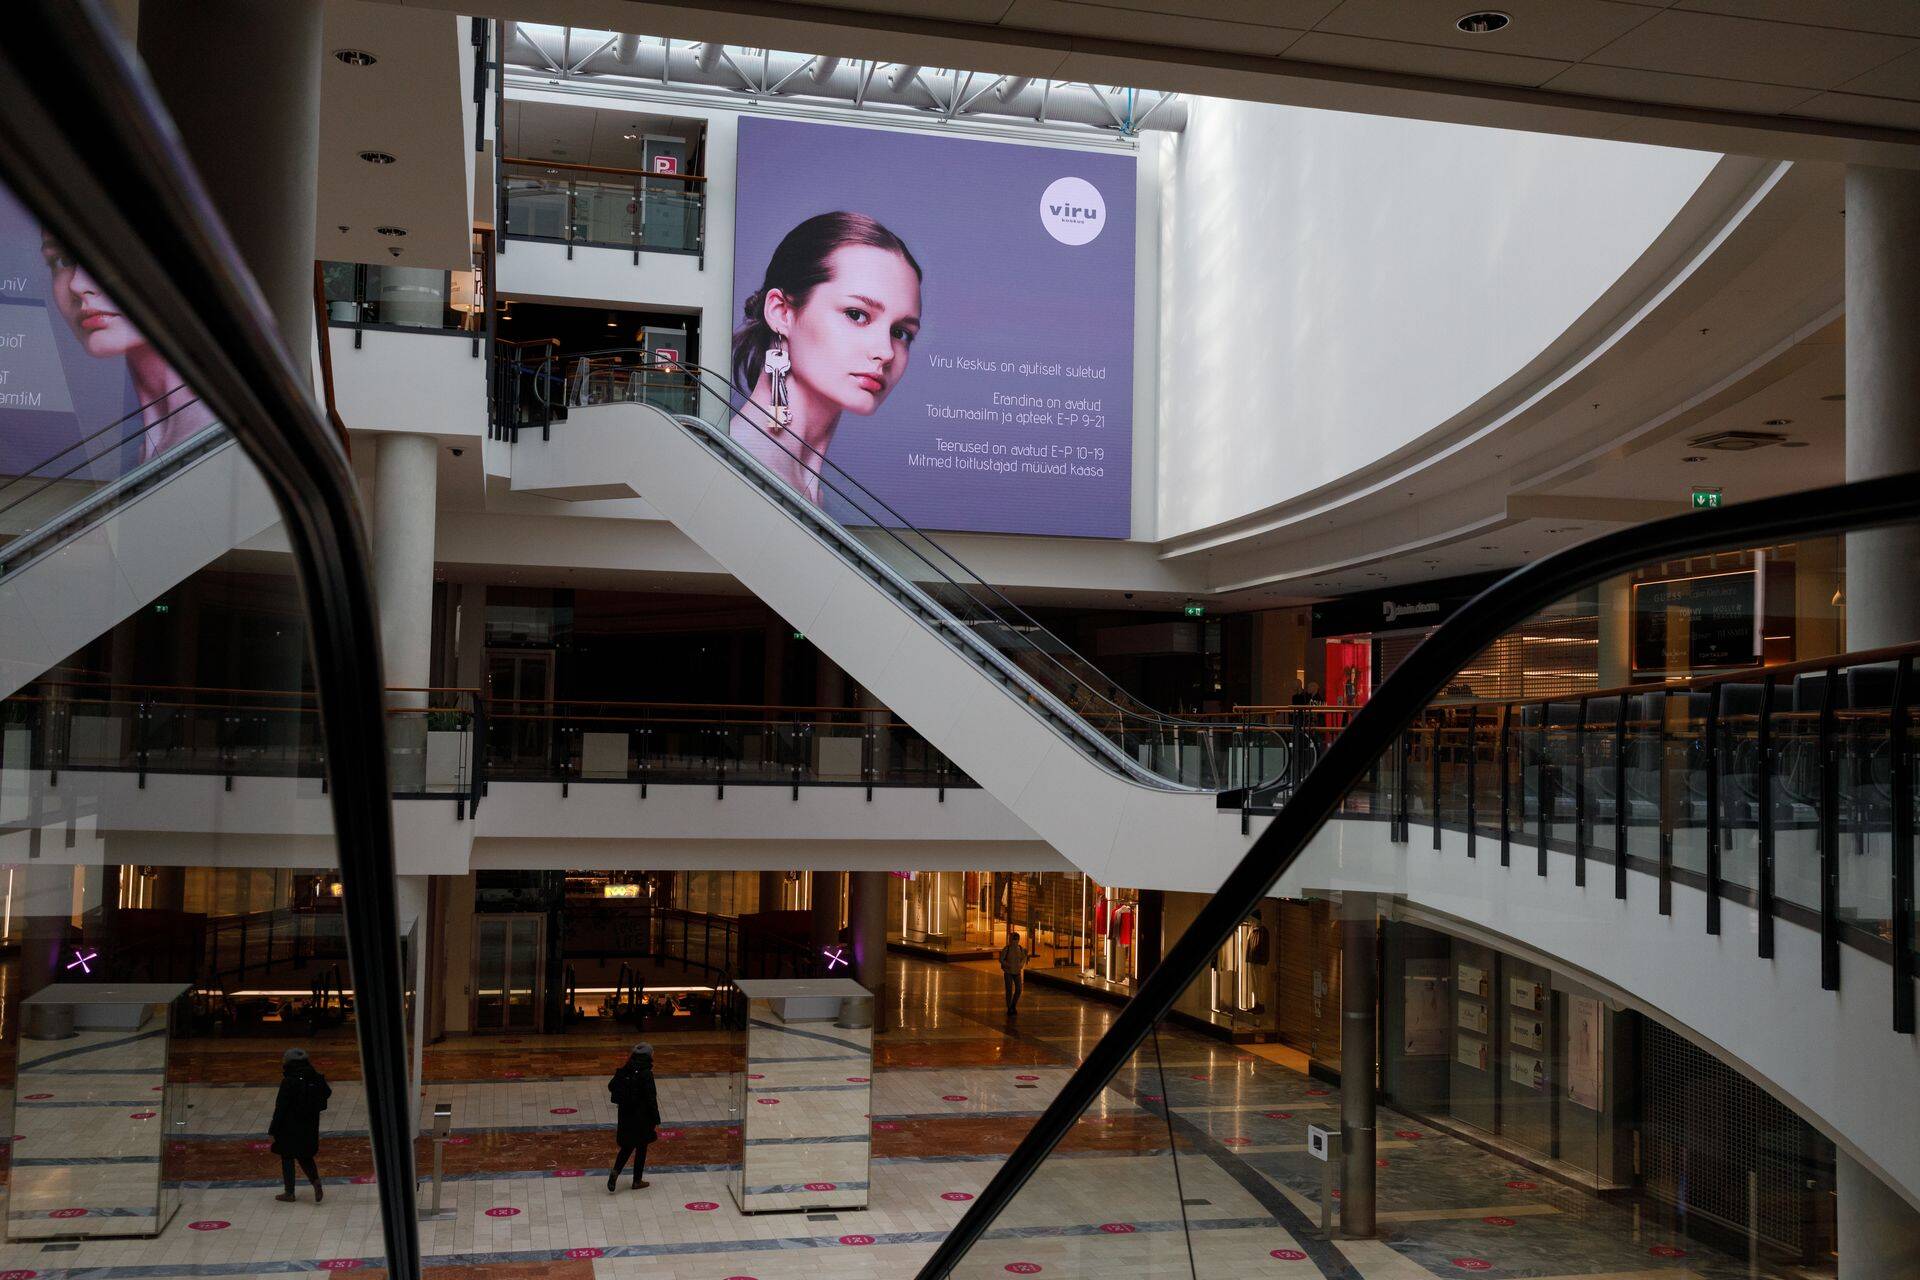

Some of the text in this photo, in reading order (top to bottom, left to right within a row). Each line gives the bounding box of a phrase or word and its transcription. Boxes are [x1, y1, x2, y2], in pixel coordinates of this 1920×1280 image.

[1050, 203, 1096, 220] viru
[929, 355, 1106, 380] Viru Keskus on ajutiselt suletud
[993, 392, 1101, 411] Erandina on avatud
[926, 404, 1104, 428] Toidumaailm ja apteek E-P 9-21
[936, 438, 1104, 460] Teenused on avatud E-P 10-19
[908, 454, 1103, 477] Mitmed toitlustajad müüvad kaasa
